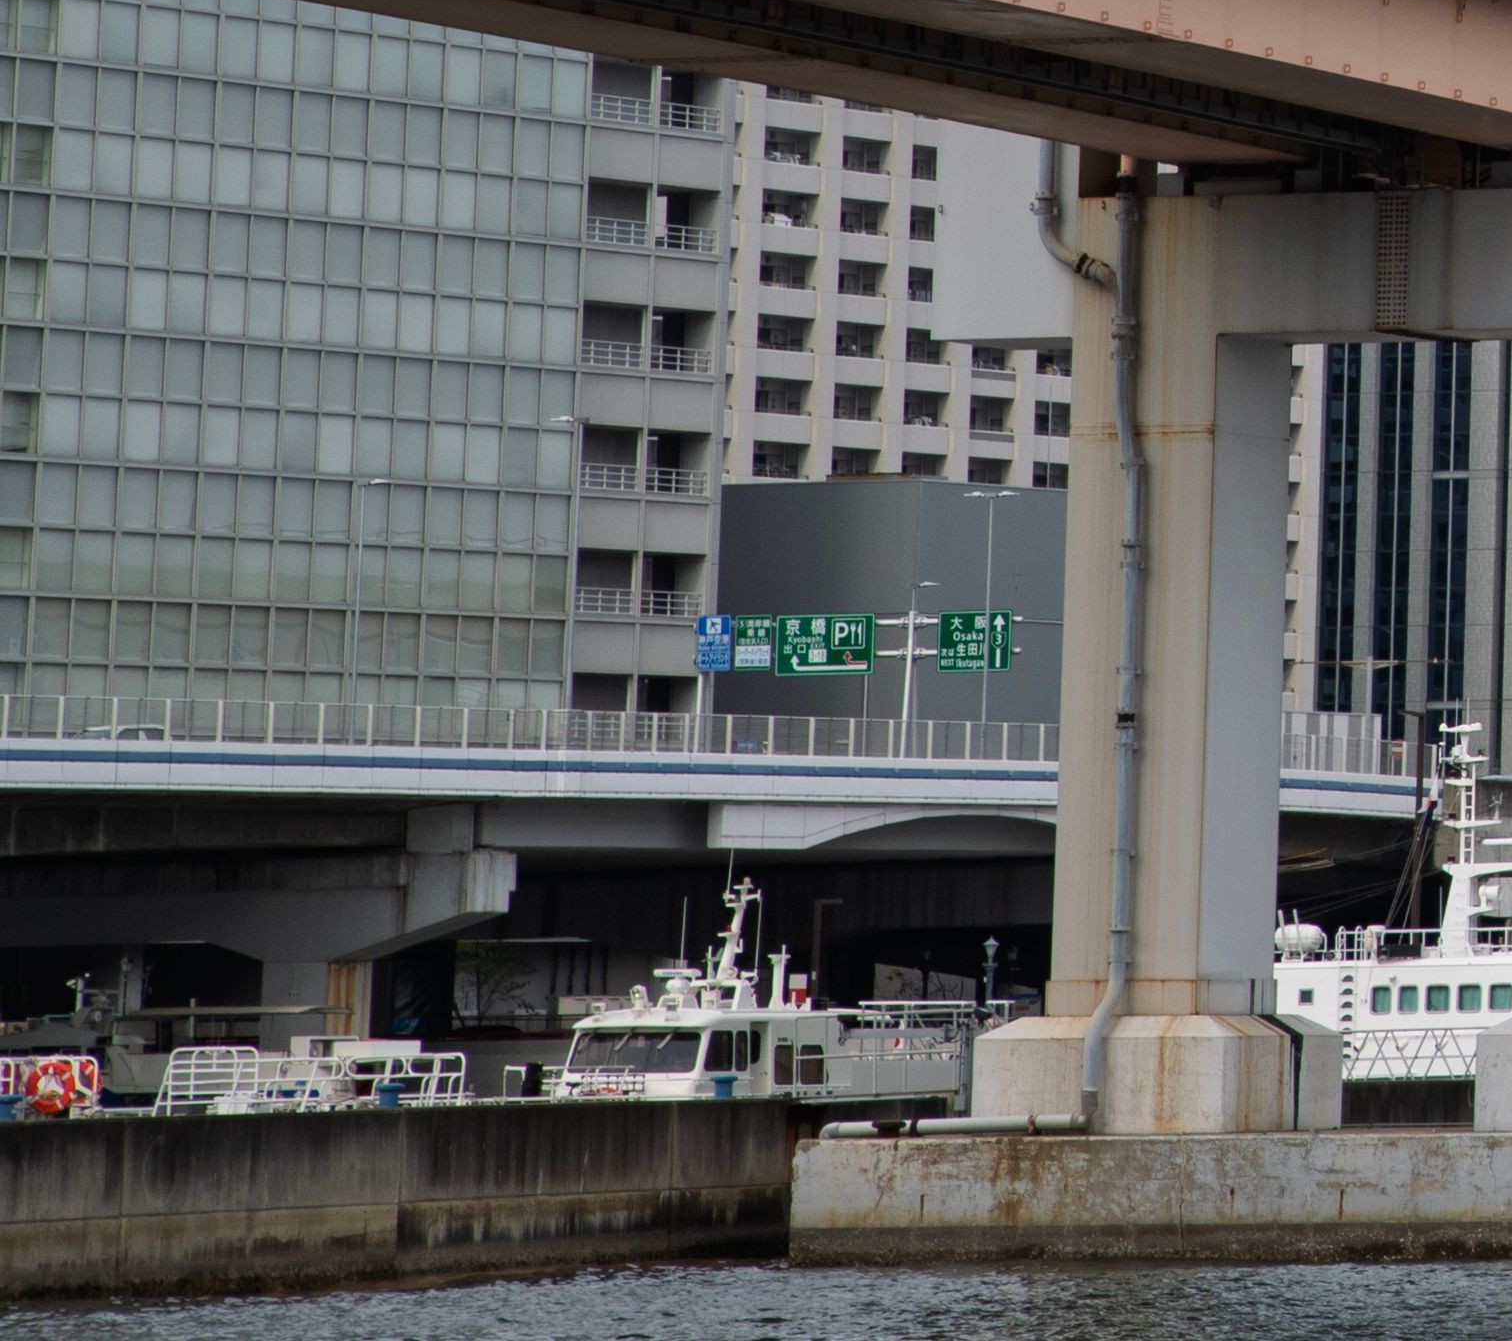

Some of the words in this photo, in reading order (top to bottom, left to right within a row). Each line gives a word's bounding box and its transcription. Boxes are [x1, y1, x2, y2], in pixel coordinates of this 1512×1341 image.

[786, 618, 826, 635] 京橋
[950, 616, 986, 629] 大阪
[953, 631, 983, 641] Osaka
[995, 634, 1002, 645] 3
[784, 644, 806, 654] 出口
